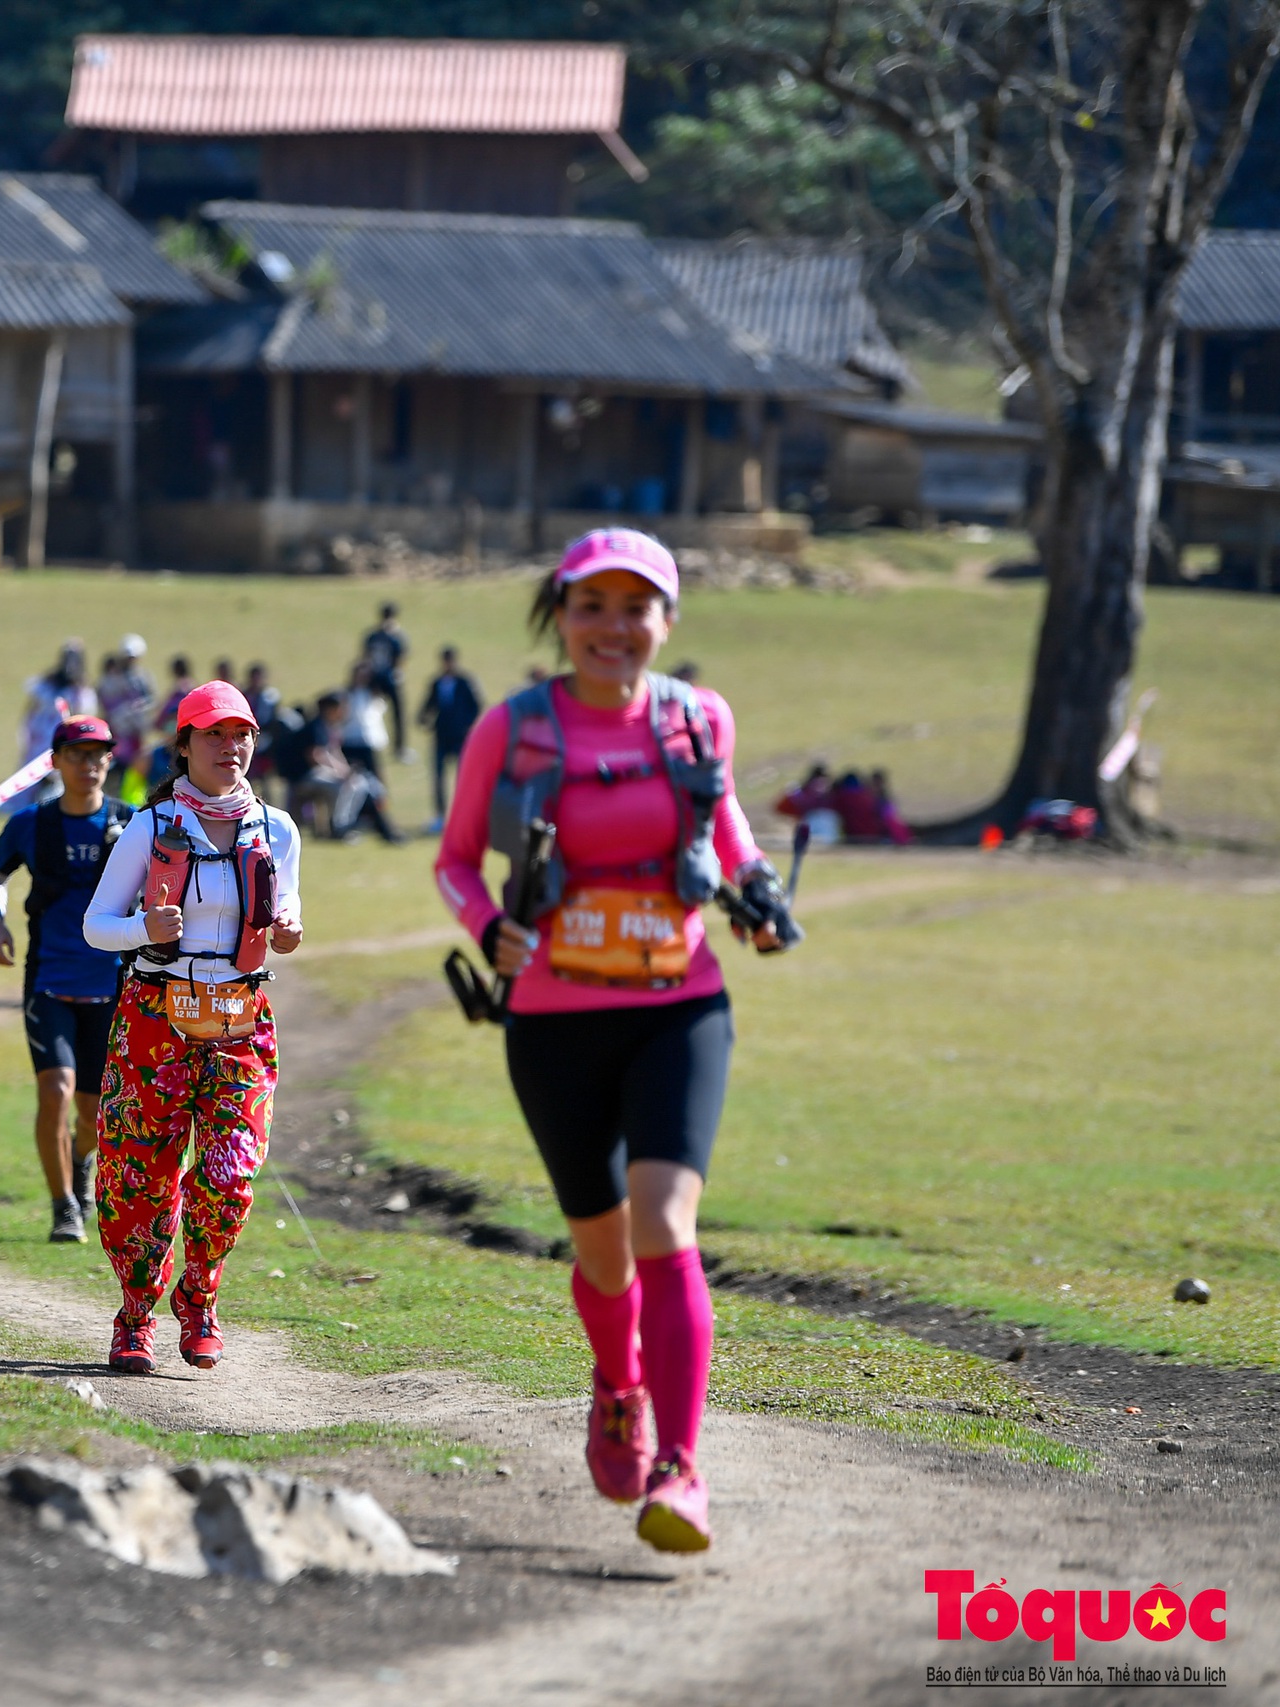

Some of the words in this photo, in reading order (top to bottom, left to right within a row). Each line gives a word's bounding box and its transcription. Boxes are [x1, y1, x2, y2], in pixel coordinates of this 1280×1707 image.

[172, 995, 200, 1008] VTM
[174, 1010, 185, 1018] 42
[186, 1010, 200, 1019] KM
